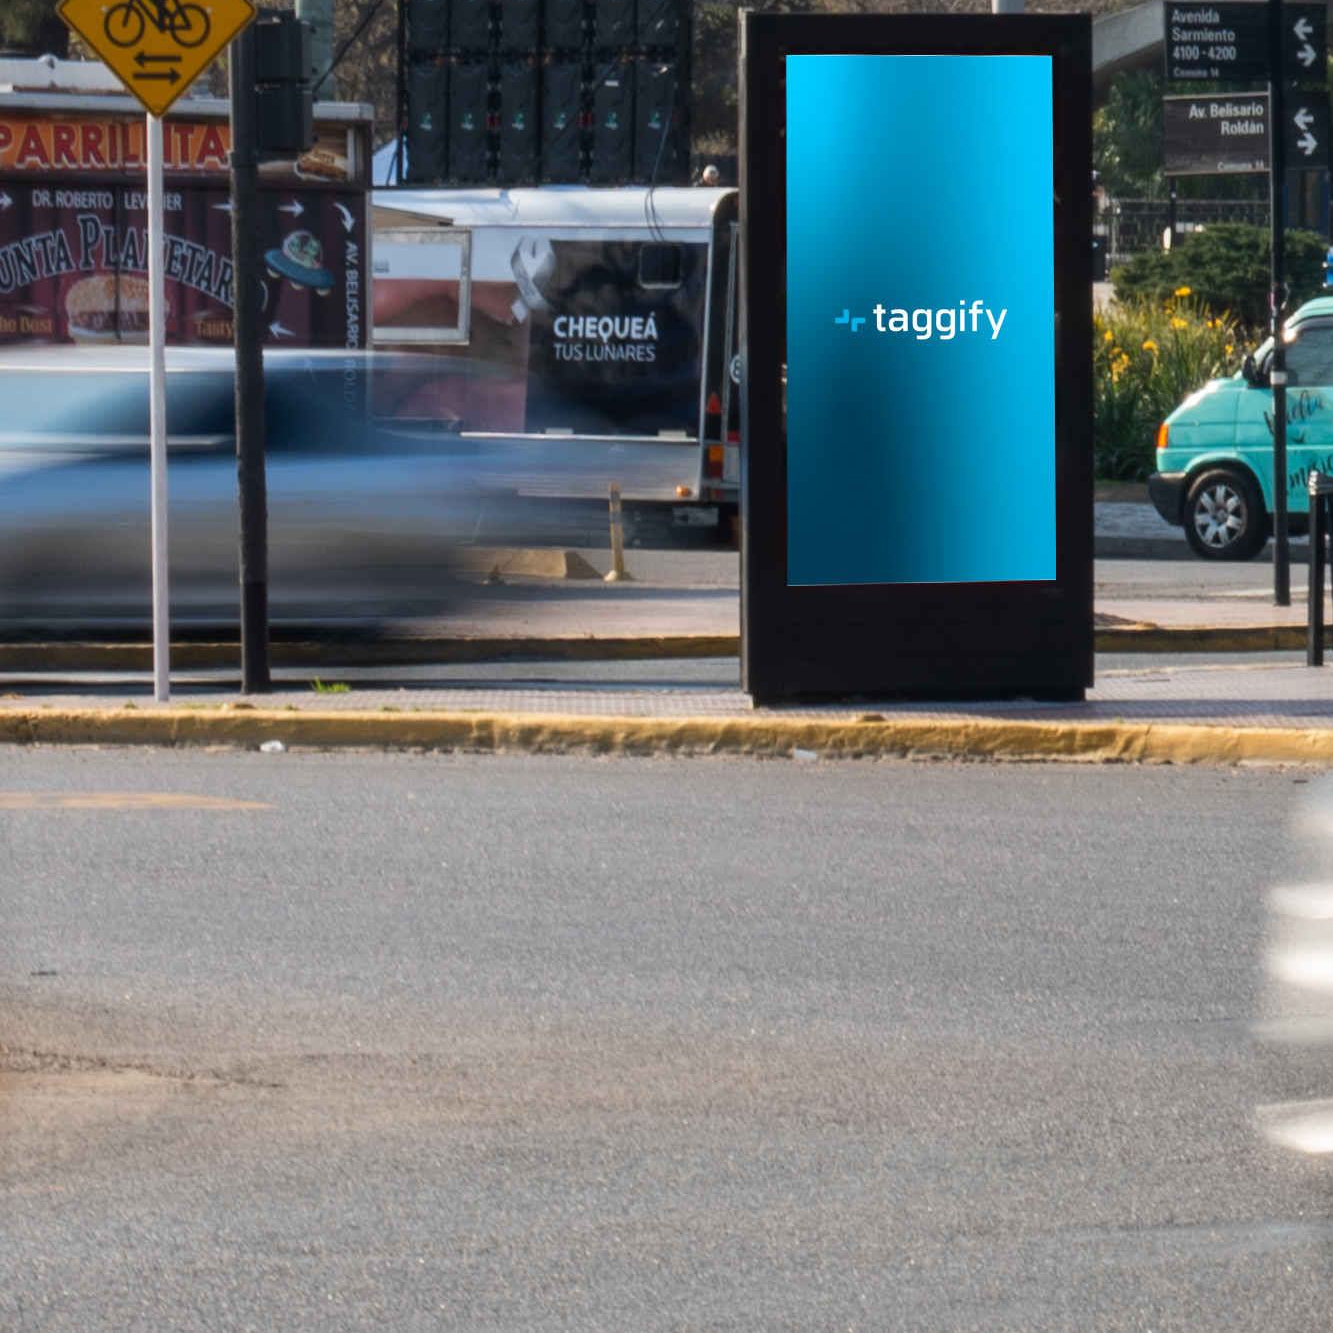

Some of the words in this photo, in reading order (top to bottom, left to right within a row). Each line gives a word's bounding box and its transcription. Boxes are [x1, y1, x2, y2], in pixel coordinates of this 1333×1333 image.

[1172, 9, 1220, 24] Avenida
[1172, 27, 1236, 42] Sarmiento
[1172, 46, 1200, 60] 4100
[1208, 46, 1237, 60] 4200
[1173, 67, 1208, 78] Comuna
[1211, 67, 1220, 78] 14
[1188, 104, 1207, 119] Av.
[1210, 102, 1264, 118] Belisario
[1221, 120, 1265, 136] Roldán
[32, 189, 53, 208] DR.
[55, 191, 114, 210] ROBERTO
[124, 191, 183, 211] LEVIER
[345, 240, 359, 265] AV.
[345, 268, 360, 350] BELISARIO
[553, 311, 659, 343] CHEQUEÁ
[873, 300, 1008, 340] taggify
[553, 343, 583, 361] TUS
[586, 344, 656, 362] LUNARES
